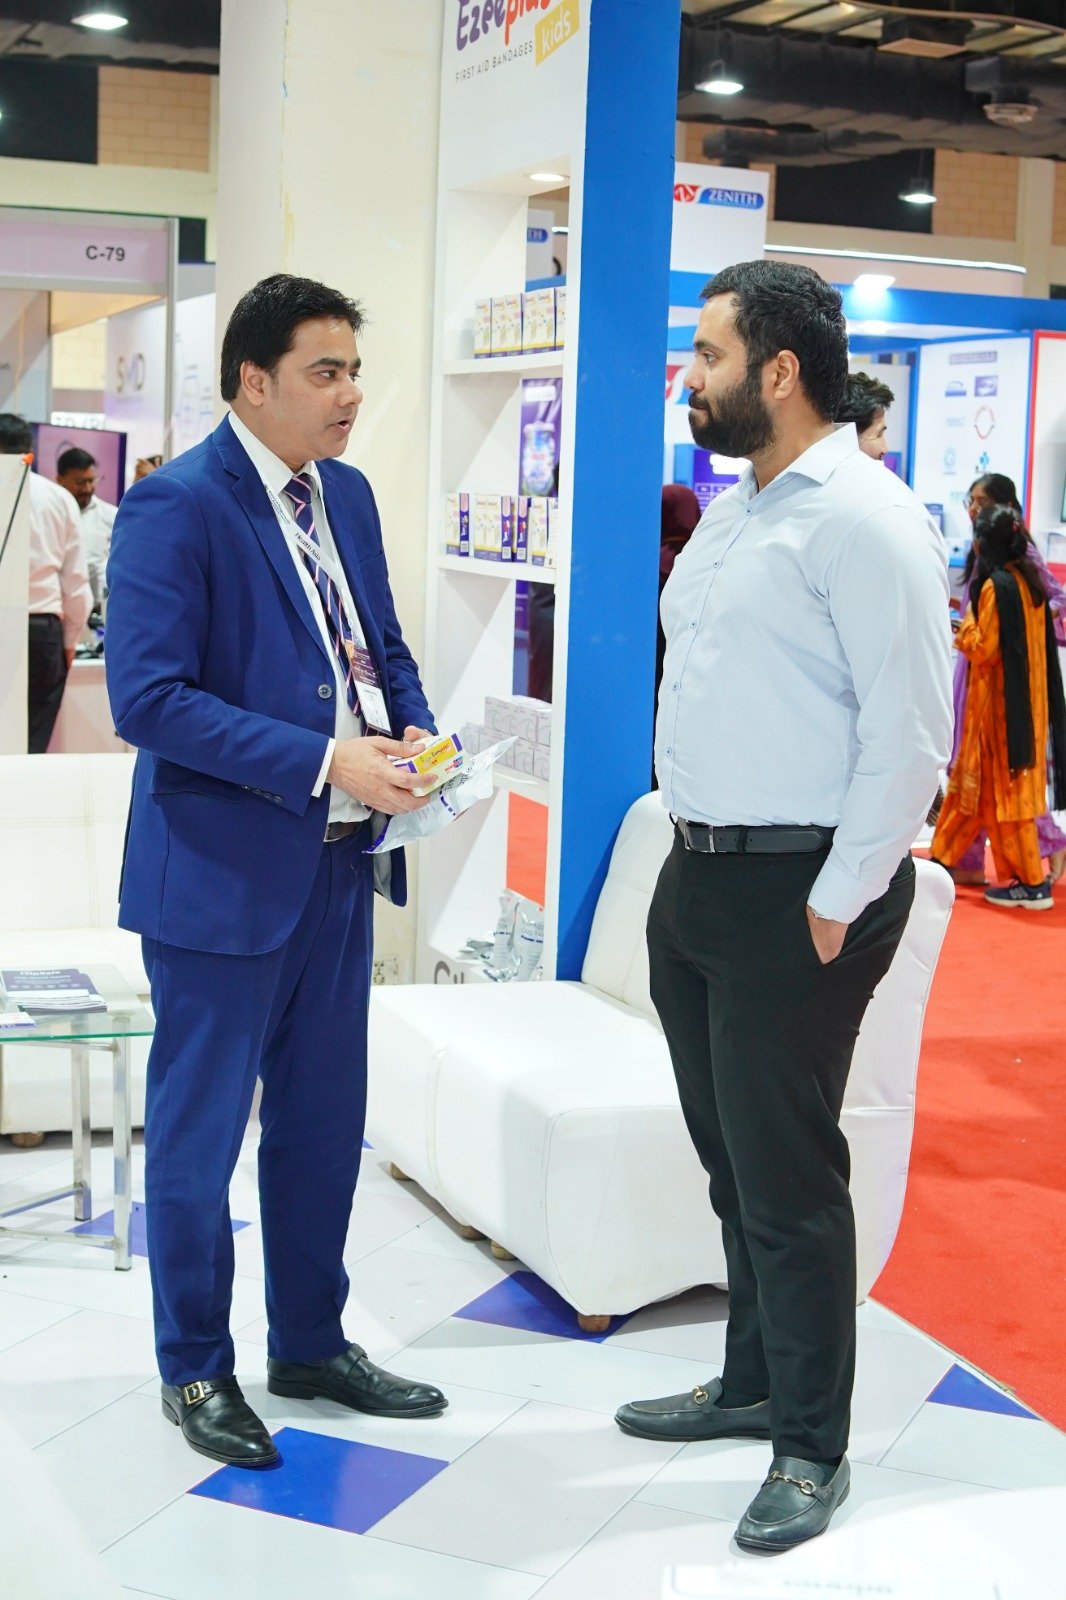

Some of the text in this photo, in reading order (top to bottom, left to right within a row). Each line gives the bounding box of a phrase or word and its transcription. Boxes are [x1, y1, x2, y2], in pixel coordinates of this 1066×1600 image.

[541, 7, 572, 55] kids
[455, 40, 533, 83] FIRST AID BANDAGES
[709, 189, 758, 206] ZENITH
[85, 245, 126, 262] C-79
[295, 532, 321, 561] Health Asia
